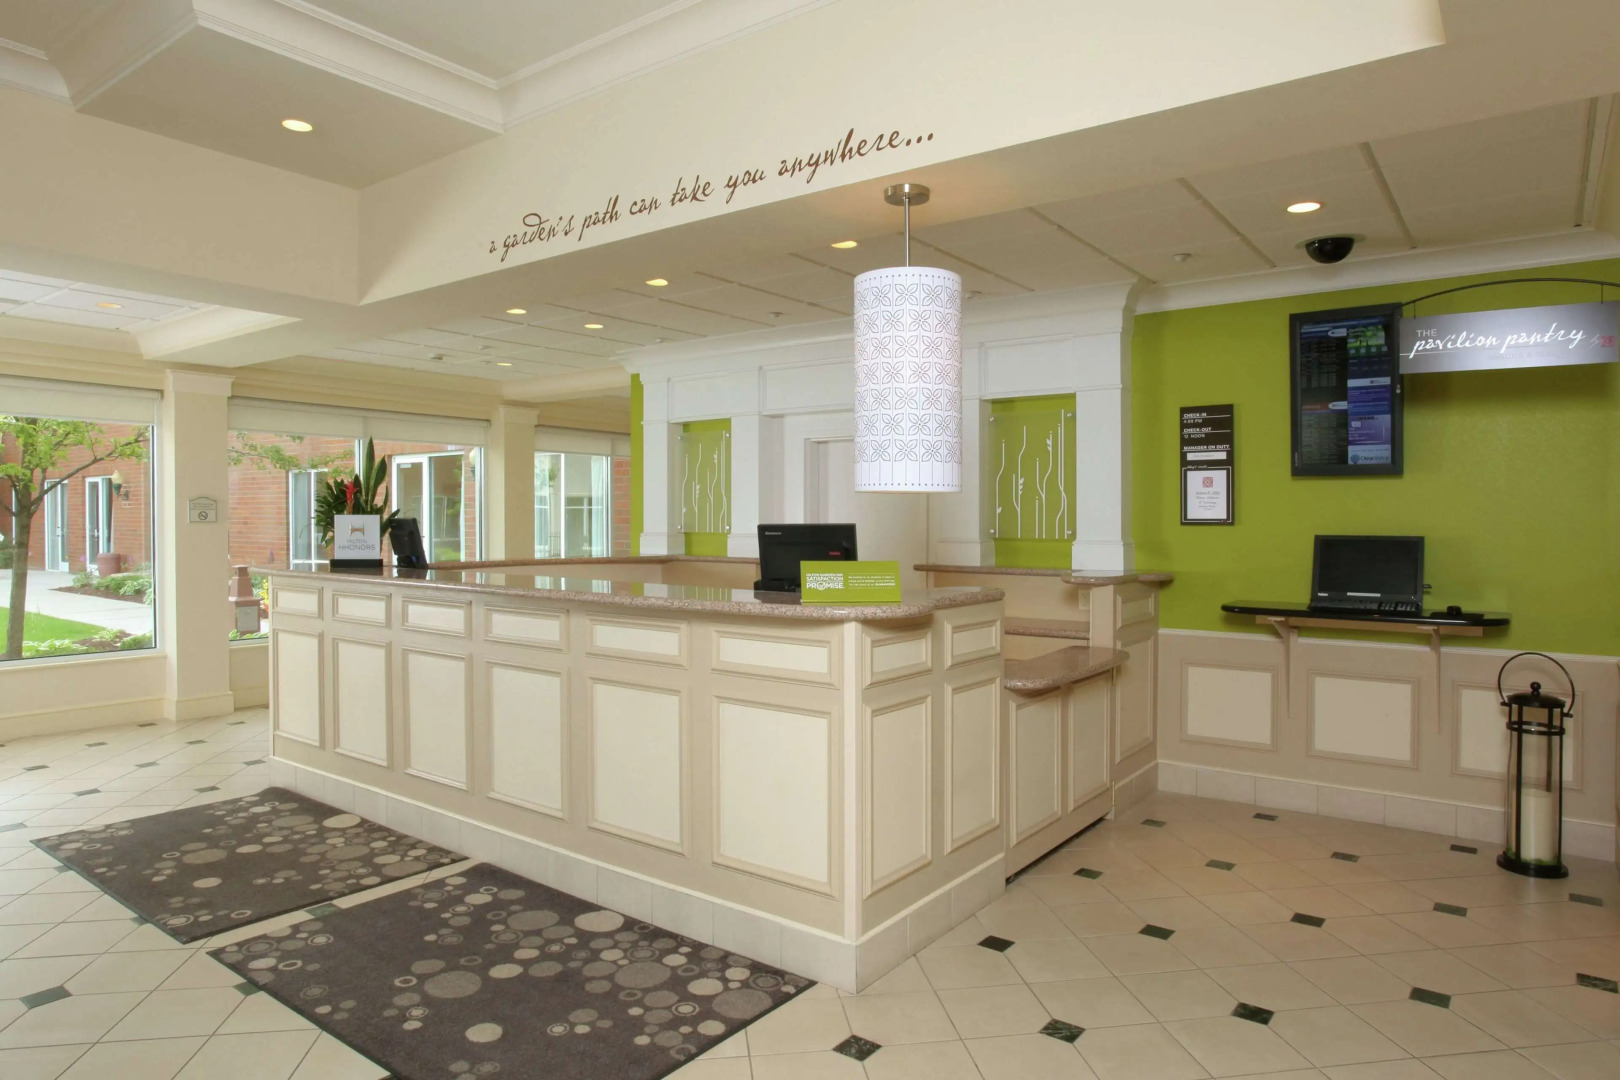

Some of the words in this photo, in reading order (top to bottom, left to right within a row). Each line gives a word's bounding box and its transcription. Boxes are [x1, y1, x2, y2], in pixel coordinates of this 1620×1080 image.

[489, 240, 497, 253] a
[501, 212, 574, 262] garden's
[578, 194, 621, 241] path
[629, 196, 661, 215] can
[669, 174, 715, 206] take
[724, 168, 766, 204] you
[778, 127, 934, 184] anywhere...
[1408, 331, 1501, 359] pavilion
[1500, 322, 1586, 353] pantry
[1416, 328, 1438, 338] THE
